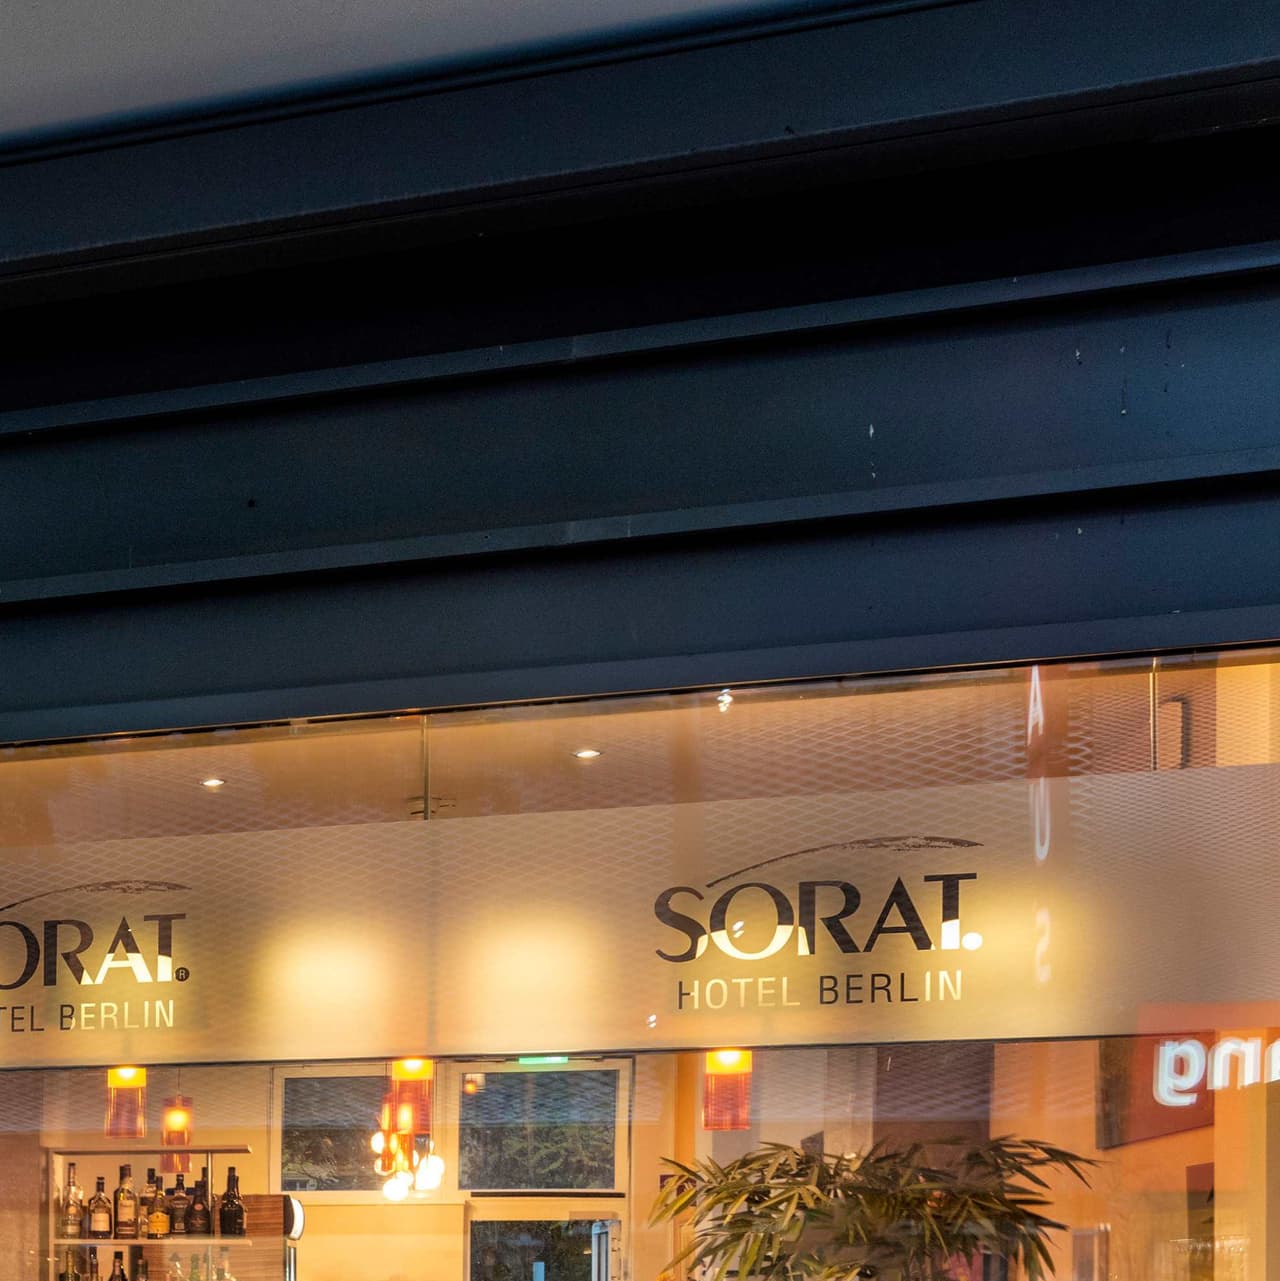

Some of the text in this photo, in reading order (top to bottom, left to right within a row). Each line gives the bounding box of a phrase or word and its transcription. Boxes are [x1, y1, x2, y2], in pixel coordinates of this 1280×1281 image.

[653, 872, 980, 963] SORAT
[677, 968, 963, 1010] HOTEL BERLIN
[59, 999, 175, 1031] BERLIN
